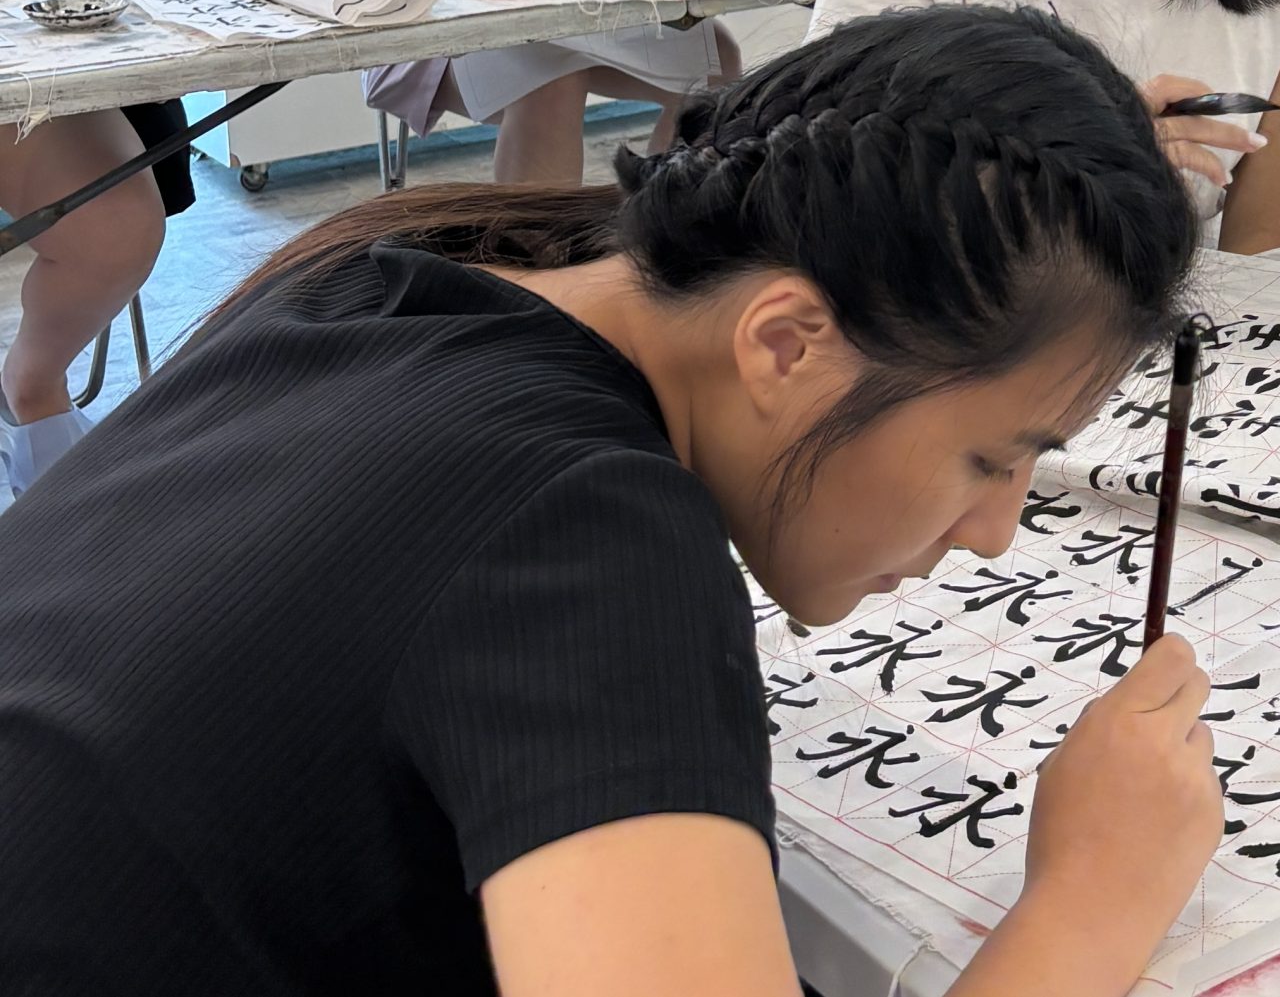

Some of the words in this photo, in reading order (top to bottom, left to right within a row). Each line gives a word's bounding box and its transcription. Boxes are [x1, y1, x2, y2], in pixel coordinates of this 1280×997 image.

[938, 568, 1074, 627] 永
[815, 619, 944, 694] 永
[919, 665, 1049, 738] 永
[795, 724, 921, 788] 永
[888, 771, 1025, 849] 永
